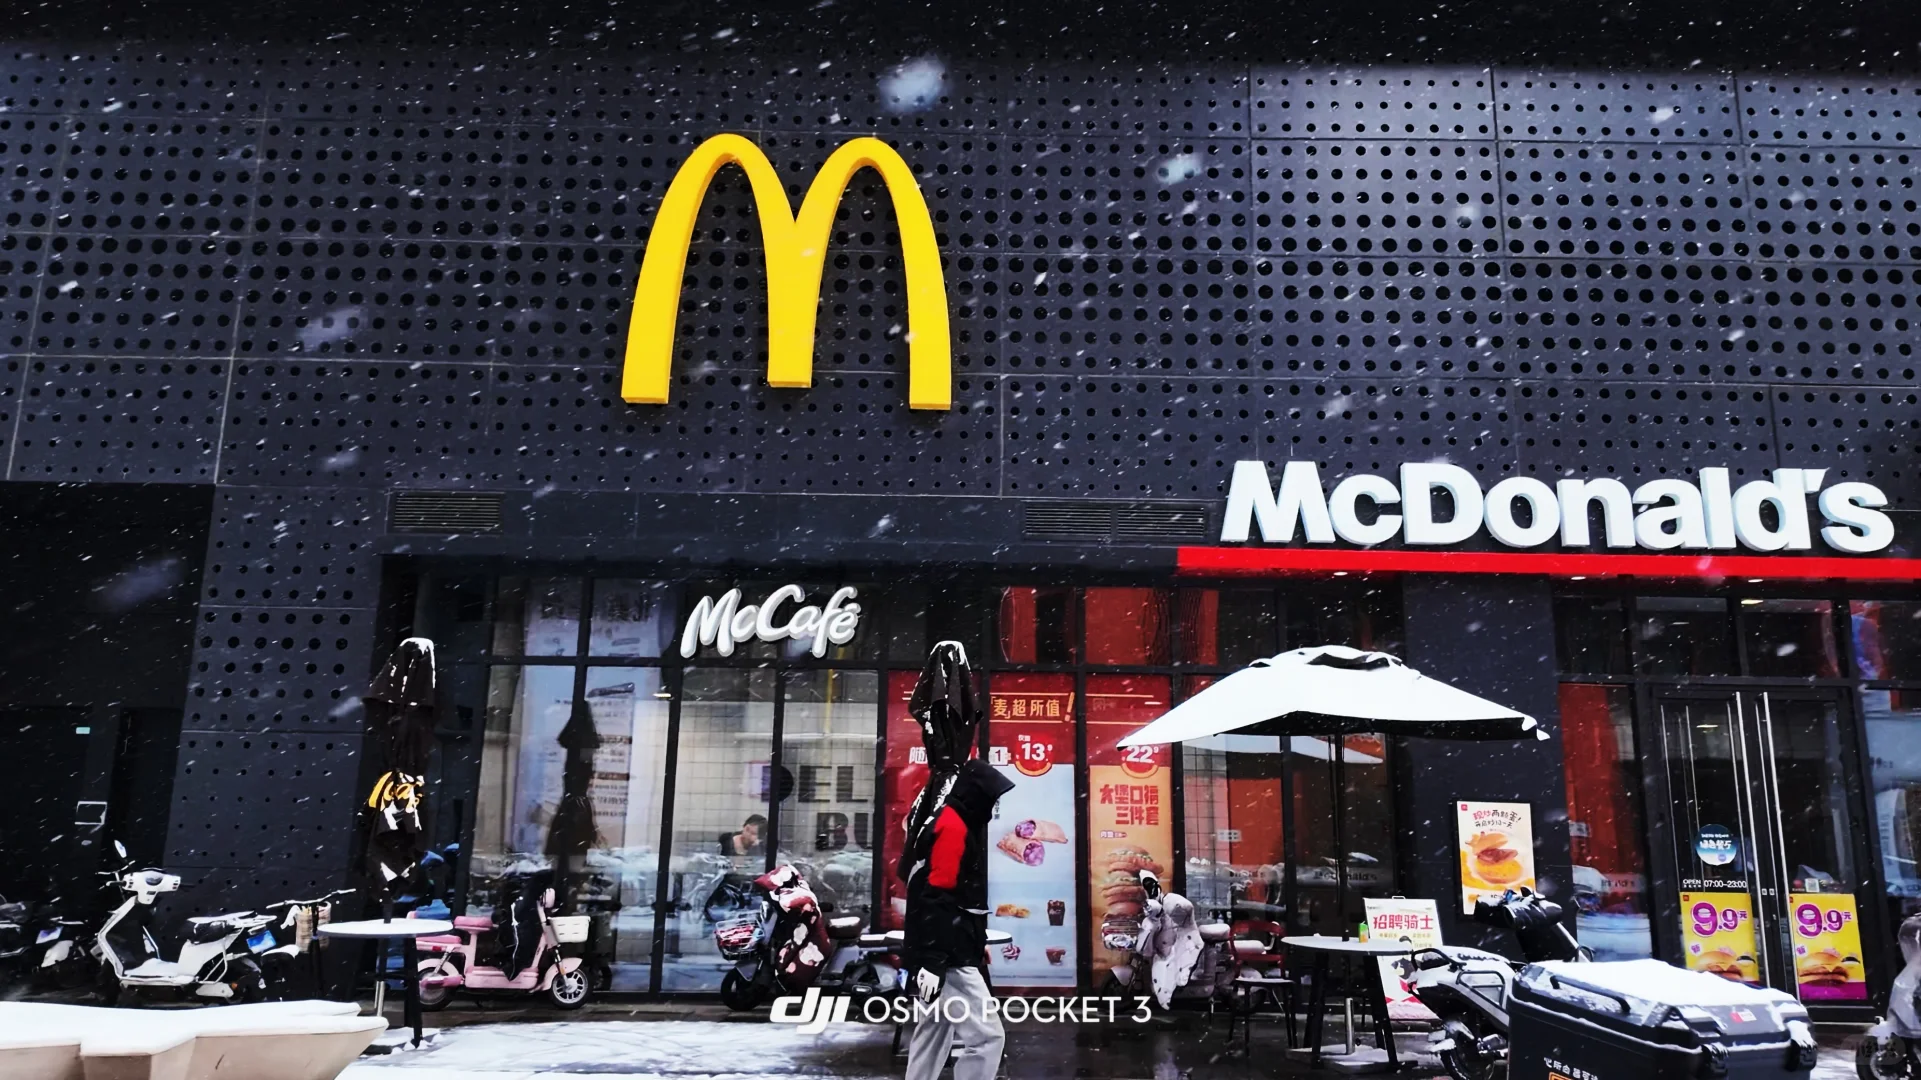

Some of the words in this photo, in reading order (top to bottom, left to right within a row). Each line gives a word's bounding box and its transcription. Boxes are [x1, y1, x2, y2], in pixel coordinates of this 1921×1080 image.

[1220, 460, 1894, 553] McDonald's
[680, 584, 861, 658] McCafé
[1100, 784, 1159, 805] 大堡口福
[1115, 806, 1159, 825] 三件套
[1373, 914, 1433, 930] 招聘骑士
